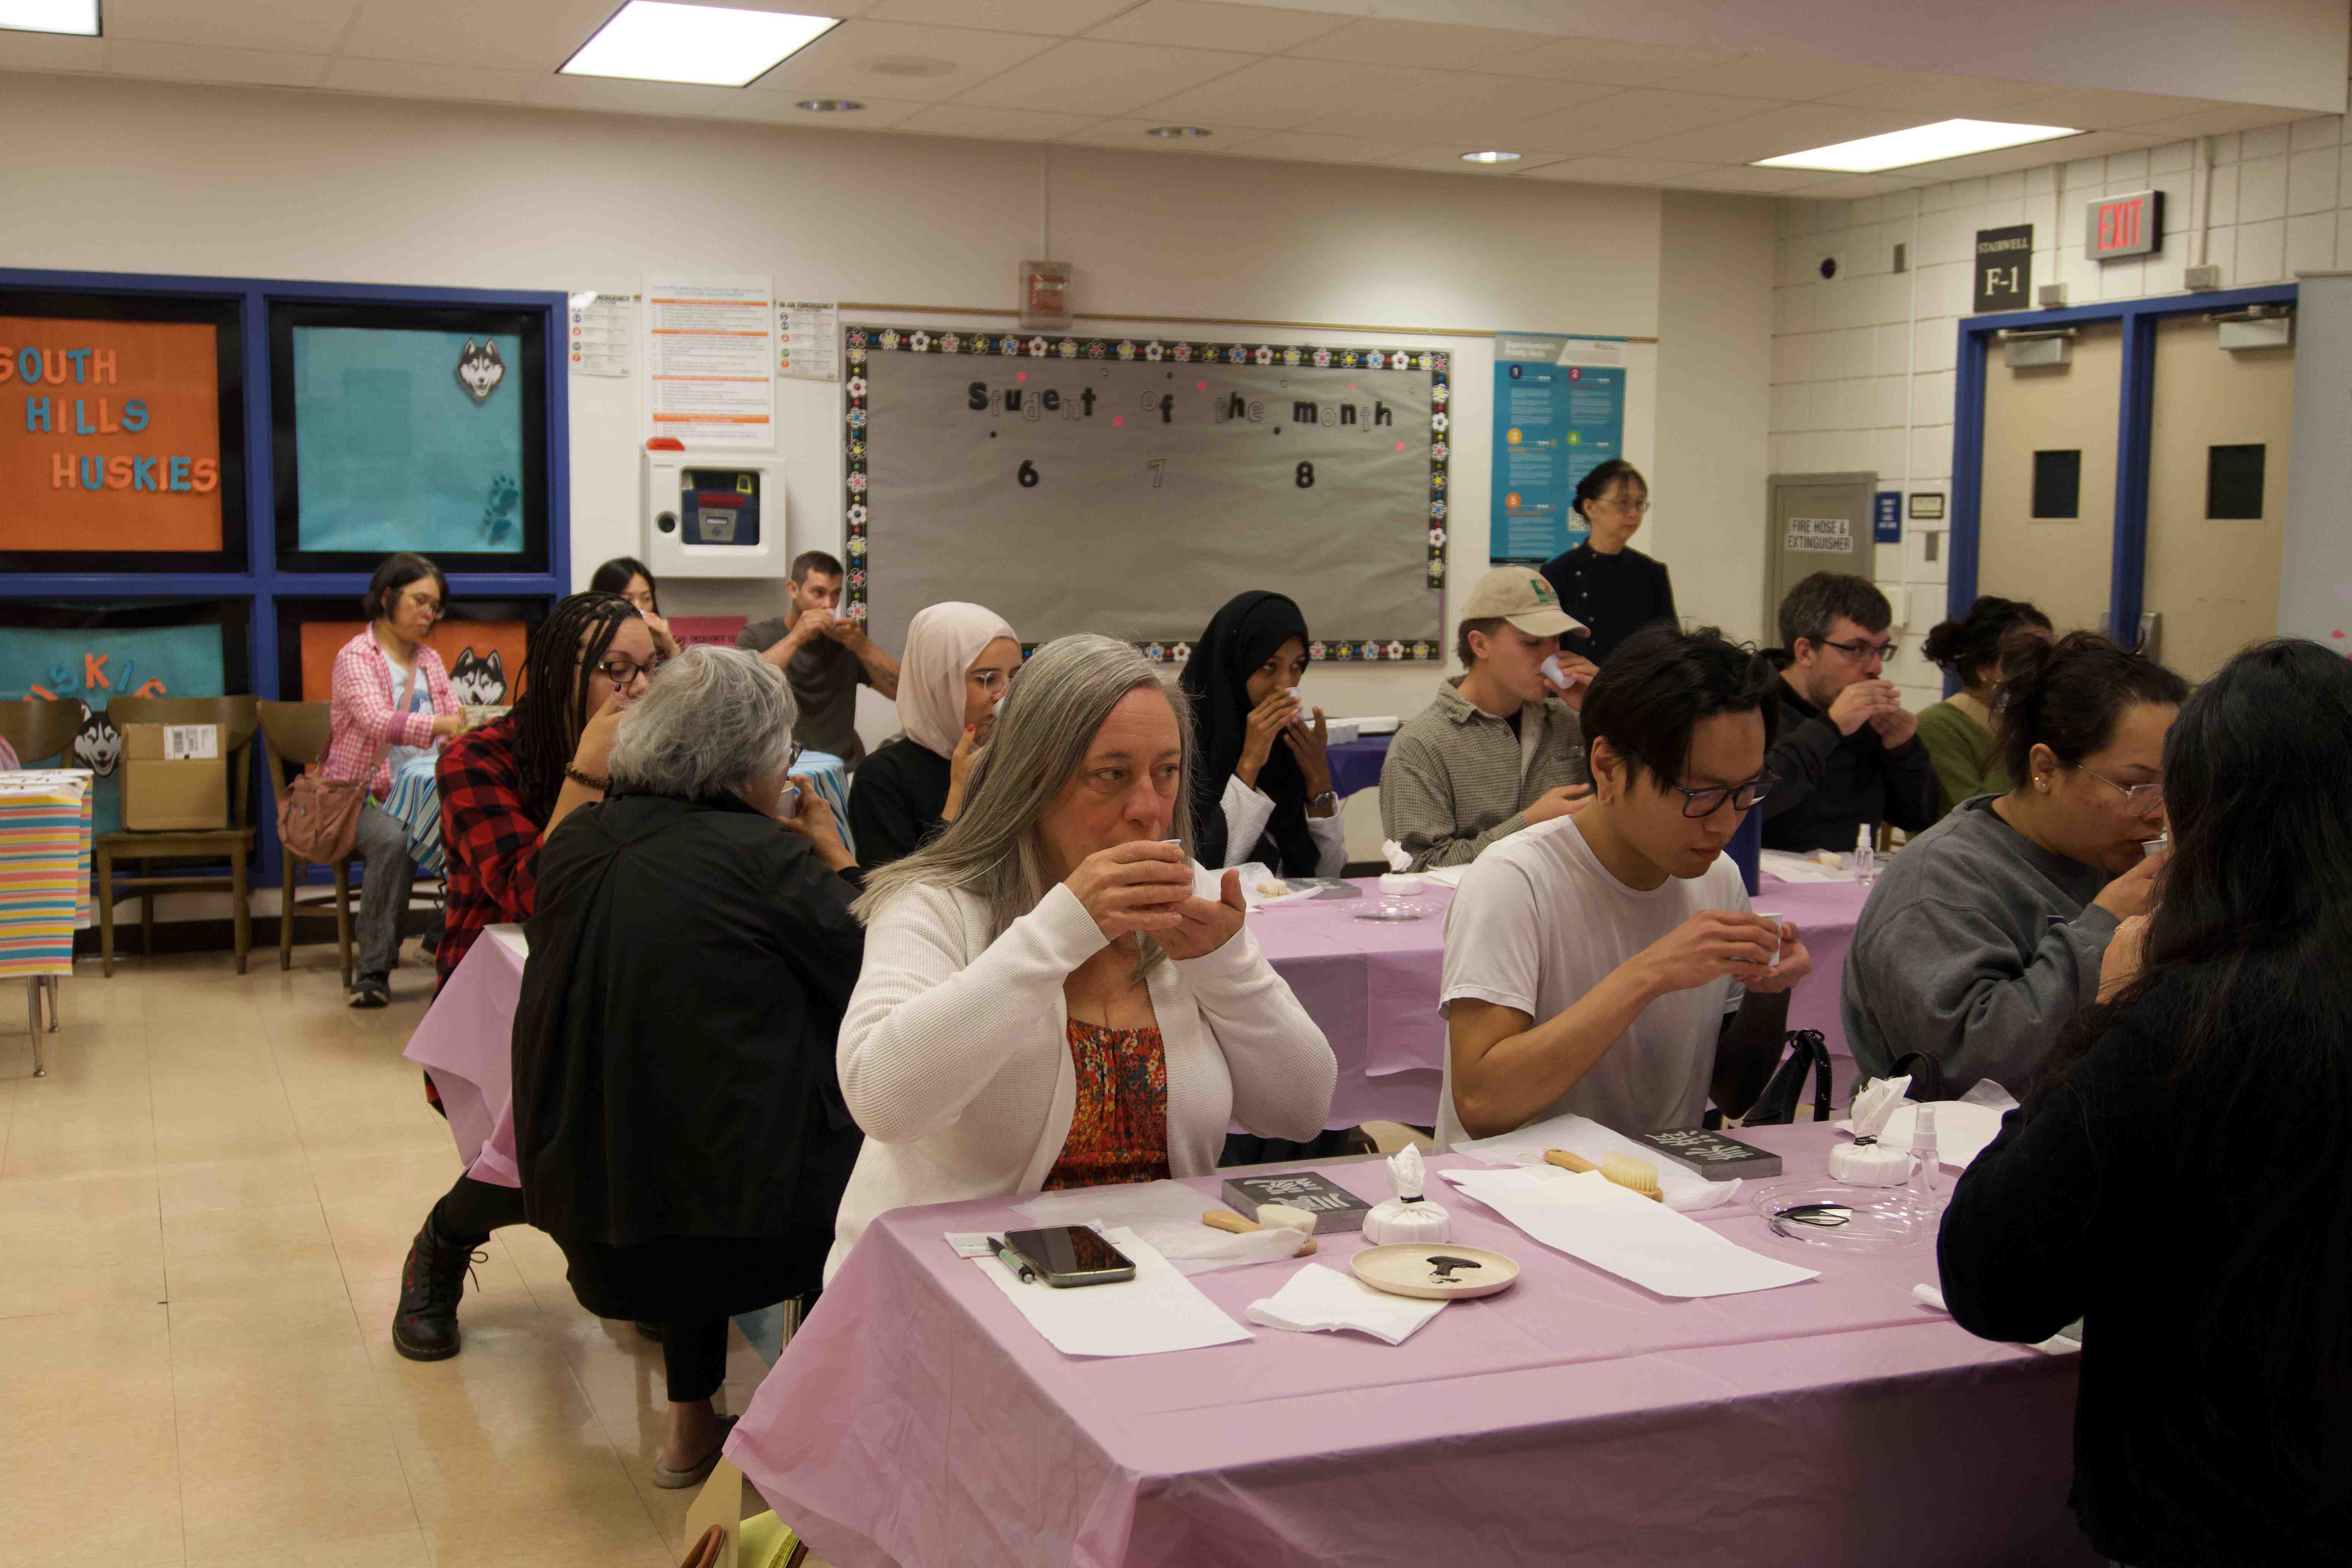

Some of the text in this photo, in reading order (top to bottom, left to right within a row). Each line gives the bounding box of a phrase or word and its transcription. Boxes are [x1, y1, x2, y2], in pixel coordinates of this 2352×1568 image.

[2098, 198, 2143, 251] EXIT
[1977, 237, 2028, 254] STAIRWELL
[1984, 266, 2019, 296] F-1
[595, 294, 630, 302] MERGENCY
[0, 346, 117, 384] SOUTH
[1573, 368, 1579, 378] 2
[26, 396, 150, 434] HILLS
[968, 381, 1393, 432] Student of the month
[1570, 433, 1577, 443] 4
[52, 453, 218, 492] HUSKIES
[1018, 458, 1315, 488] 6 7 8
[1511, 496, 1517, 505] 5
[1792, 520, 1846, 534] FIRE HOSE &
[1788, 536, 1851, 550] EXTINGUISHER
[689, 635, 725, 643] EMERGENCY
